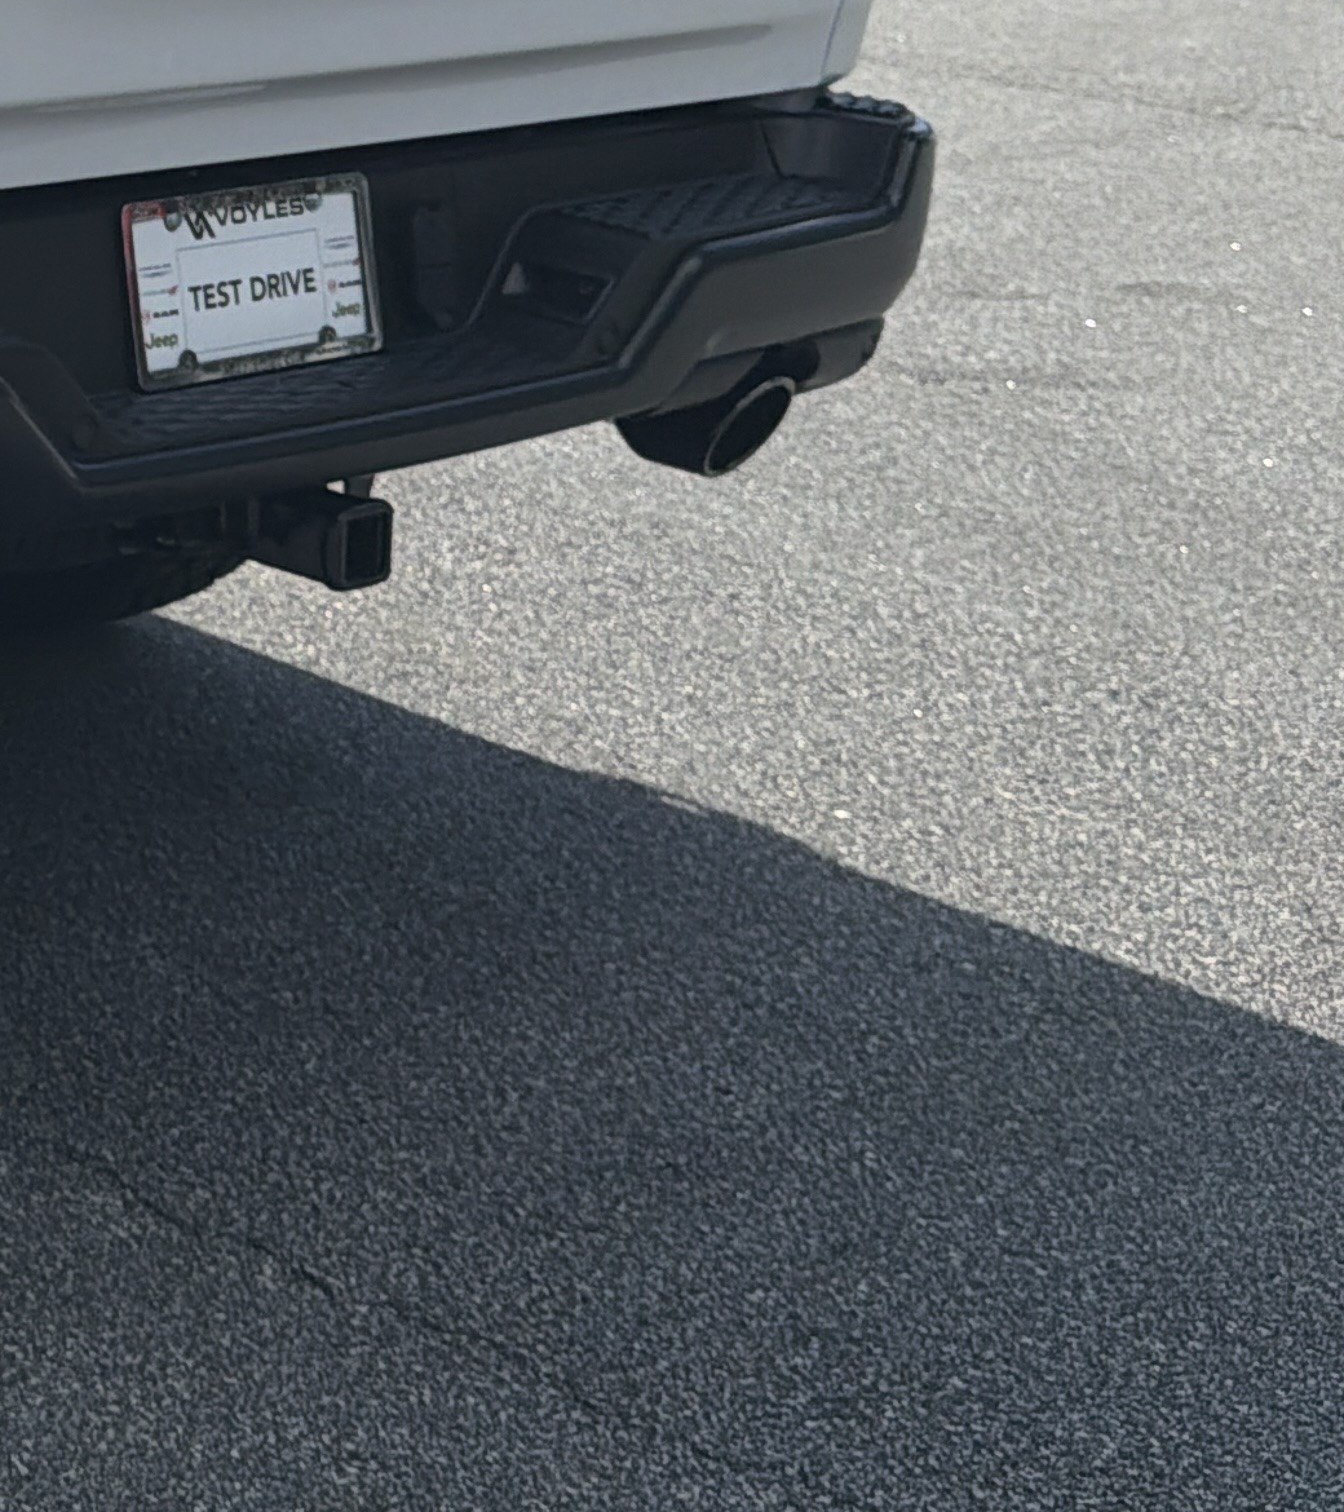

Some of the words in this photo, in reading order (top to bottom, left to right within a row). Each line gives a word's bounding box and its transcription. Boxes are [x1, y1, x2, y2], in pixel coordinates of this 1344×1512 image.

[213, 196, 306, 227] VOYLES
[187, 279, 244, 312] TEST
[249, 268, 318, 303] DRIVE
[144, 332, 179, 350] Jeep
